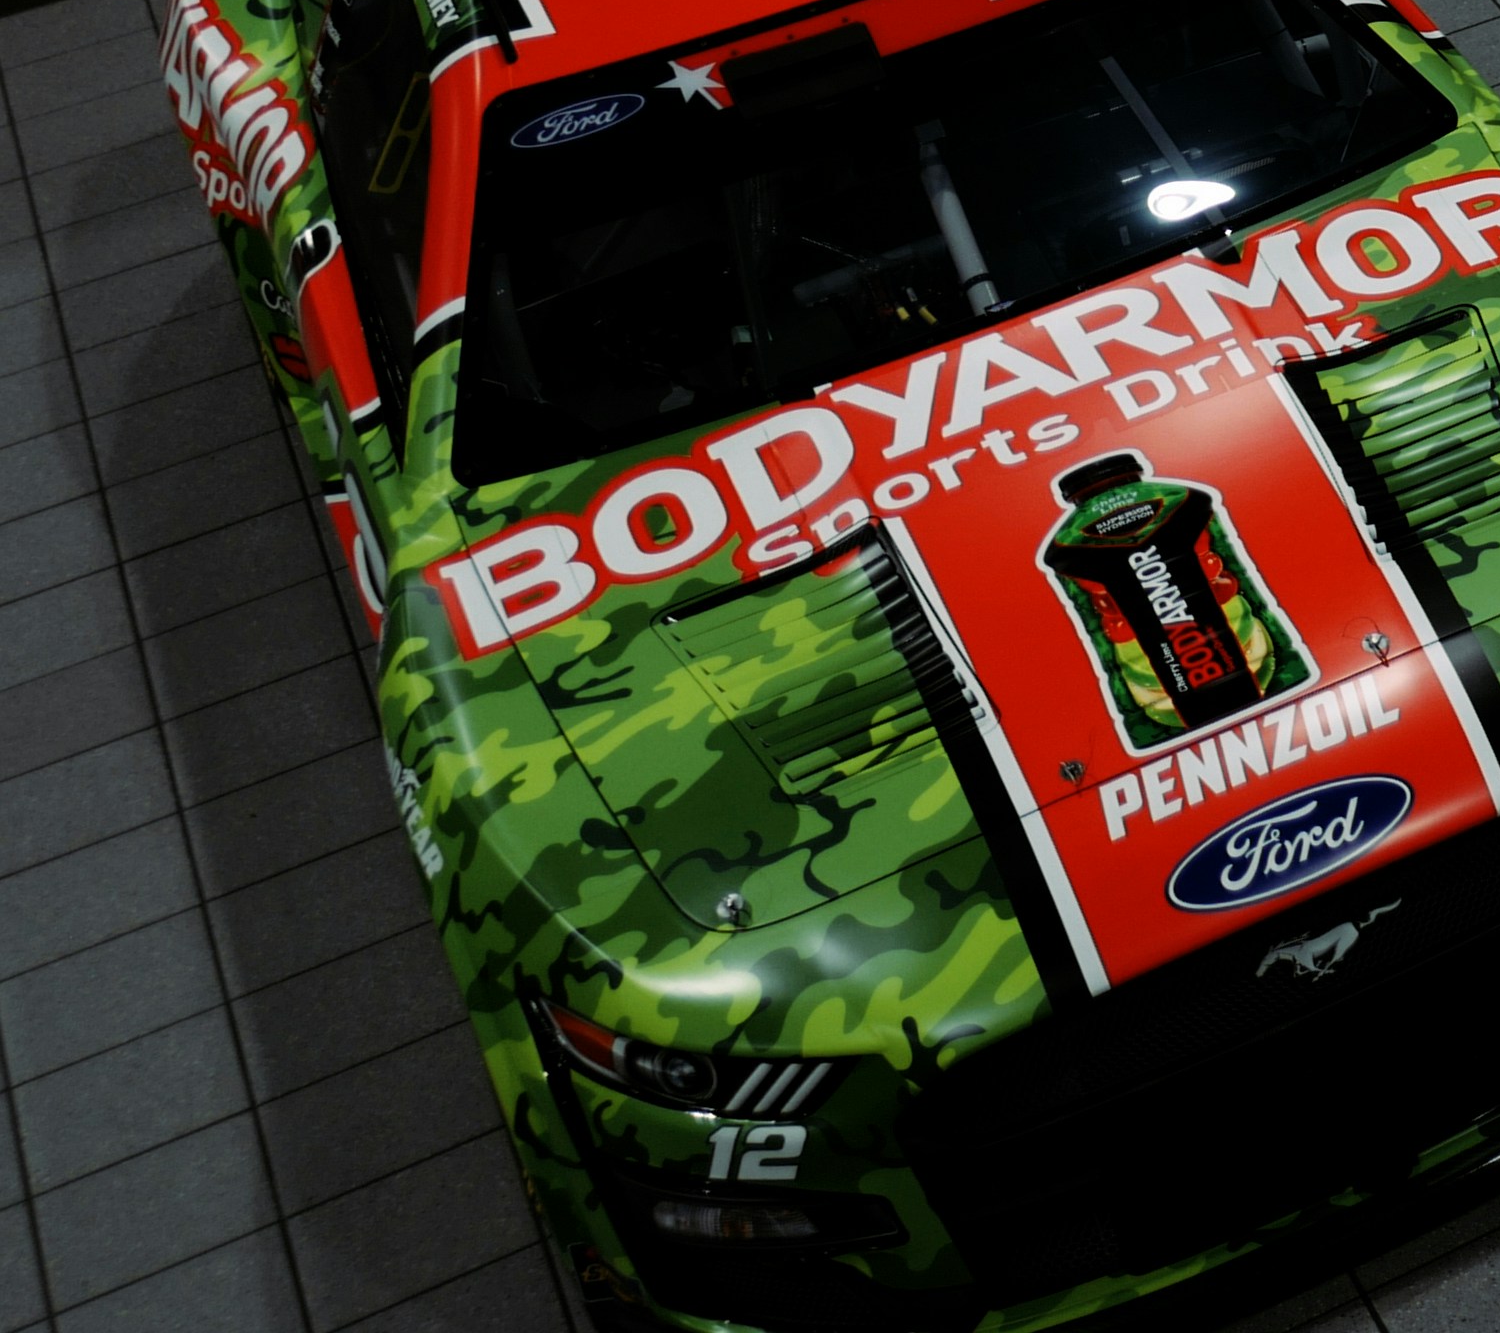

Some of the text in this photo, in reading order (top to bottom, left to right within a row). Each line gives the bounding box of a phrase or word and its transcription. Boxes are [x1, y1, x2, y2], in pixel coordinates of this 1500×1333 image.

[541, 101, 618, 141] Ford
[747, 318, 1371, 576] Sports Drink
[1096, 504, 1153, 530] SUPERIOR
[1098, 508, 1155, 536] HYDRATION
[1128, 544, 1225, 690] BODYARMOR
[1101, 683, 1402, 843] PENNZOIL
[1216, 791, 1365, 892] Ford
[705, 1123, 807, 1183] 12
